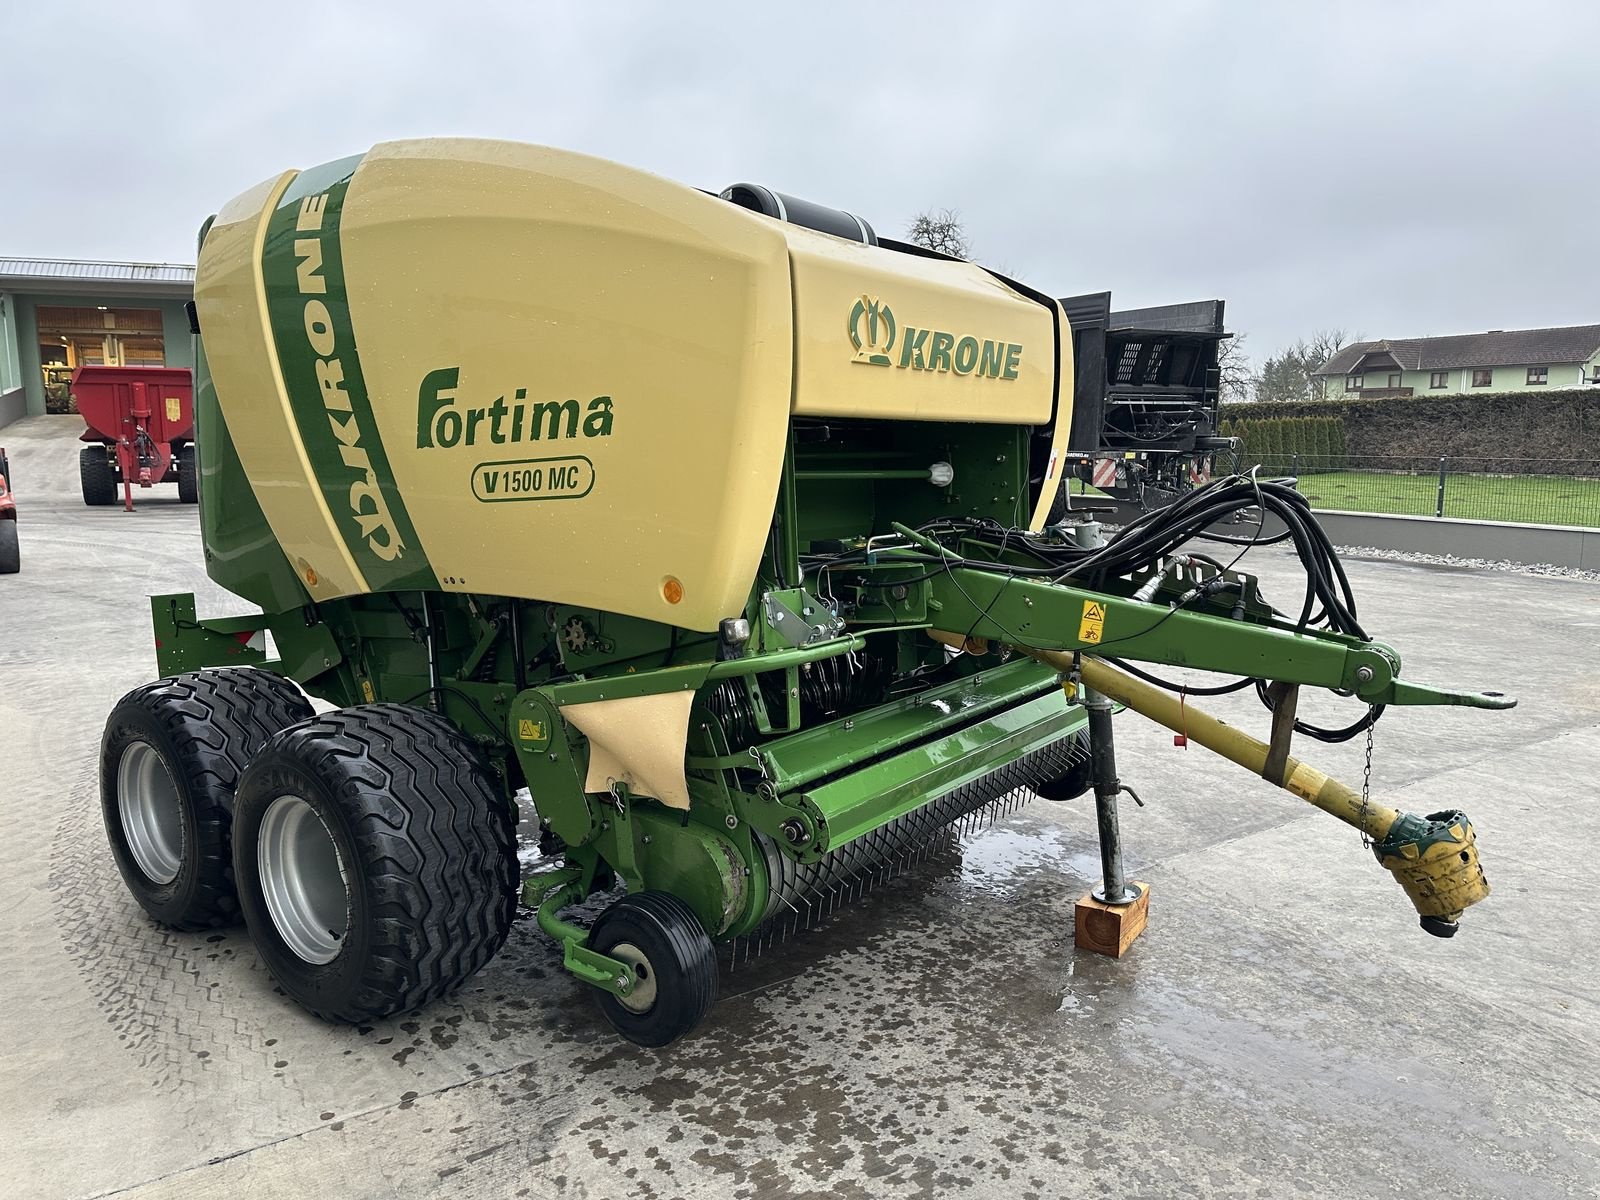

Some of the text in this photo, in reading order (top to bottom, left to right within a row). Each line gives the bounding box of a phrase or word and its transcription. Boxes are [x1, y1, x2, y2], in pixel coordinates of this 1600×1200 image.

[294, 193, 370, 468] KRONE
[897, 326, 1022, 380] KRONE
[416, 366, 614, 449] Fortima
[483, 465, 579, 494] V 1500 MC
